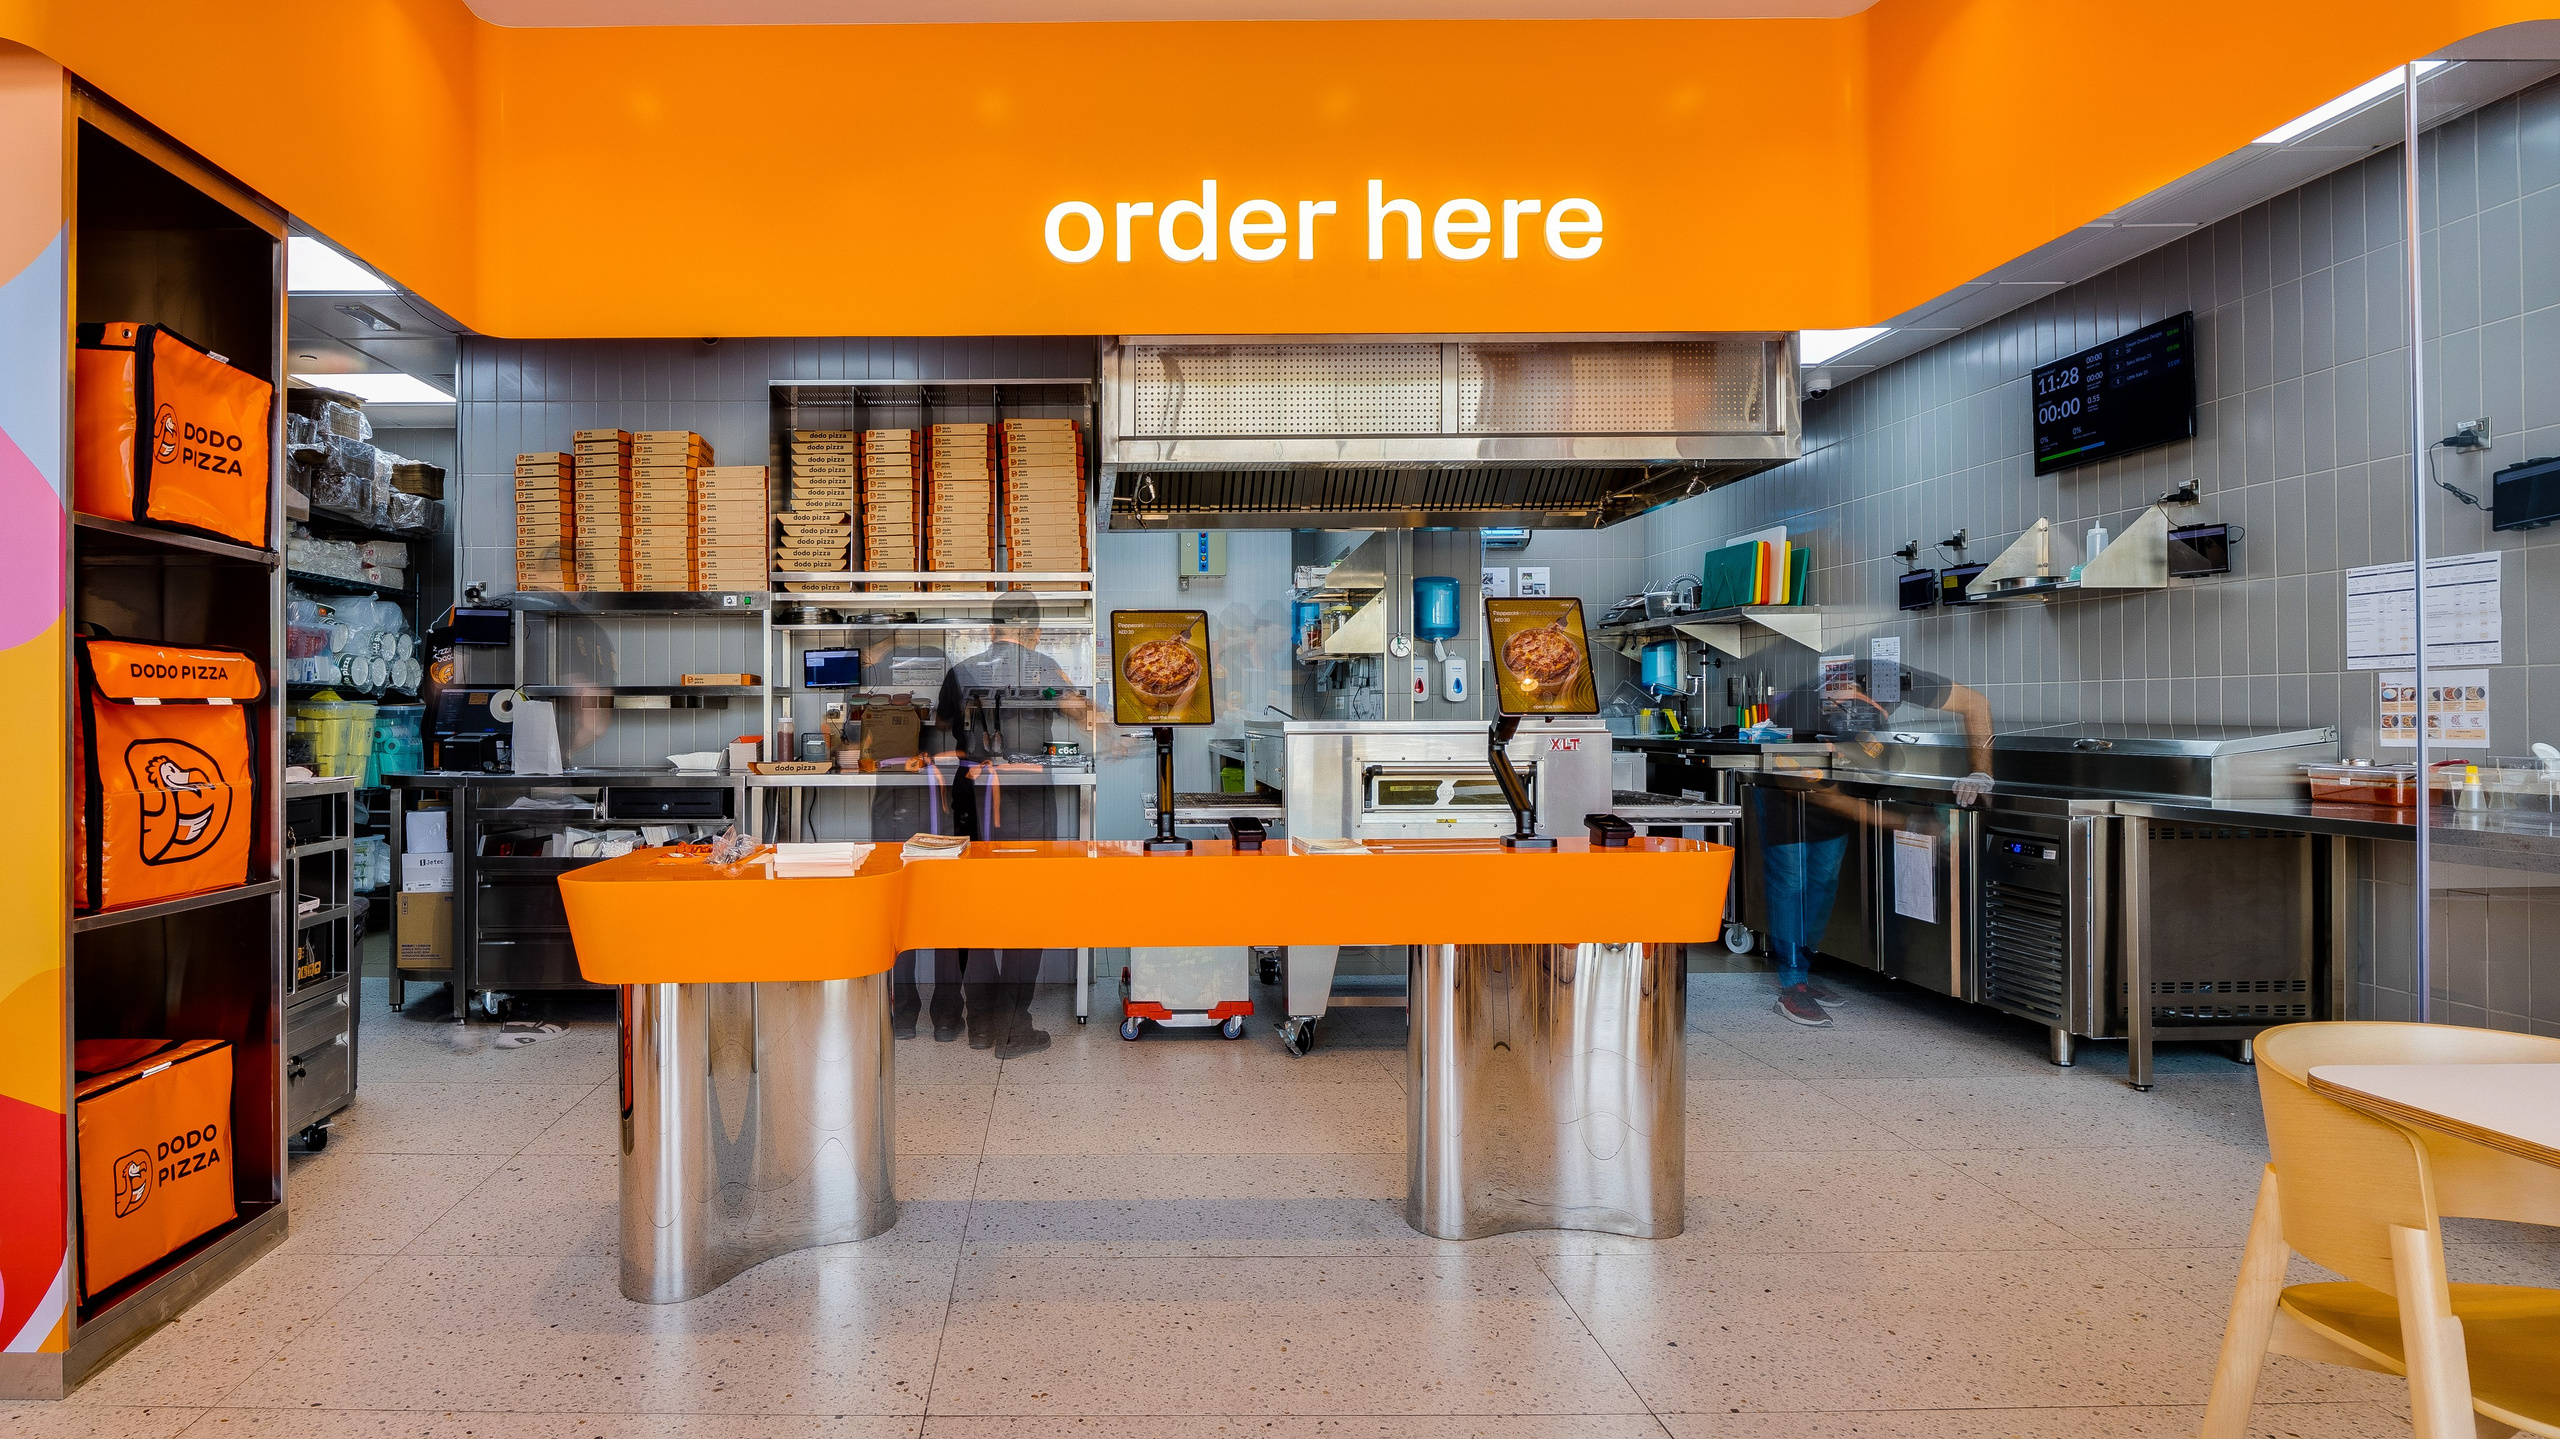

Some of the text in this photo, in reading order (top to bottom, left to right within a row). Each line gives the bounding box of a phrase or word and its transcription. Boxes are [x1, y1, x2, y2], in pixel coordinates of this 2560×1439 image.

[1044, 179, 1603, 264] order here
[2086, 352, 2102, 364] 00:00
[2038, 366, 2080, 396] 11:28
[2086, 371, 2103, 383] 00:00
[2039, 397, 2080, 424] 00:00
[184, 422, 242, 452] DODO
[183, 447, 242, 477] PIZZA
[130, 664, 228, 680] DODO PIZZA
[1551, 738, 1580, 750] XLT
[797, 764, 816, 772] pizza
[158, 1124, 217, 1162] DODO
[158, 1148, 220, 1188] PIZZA
